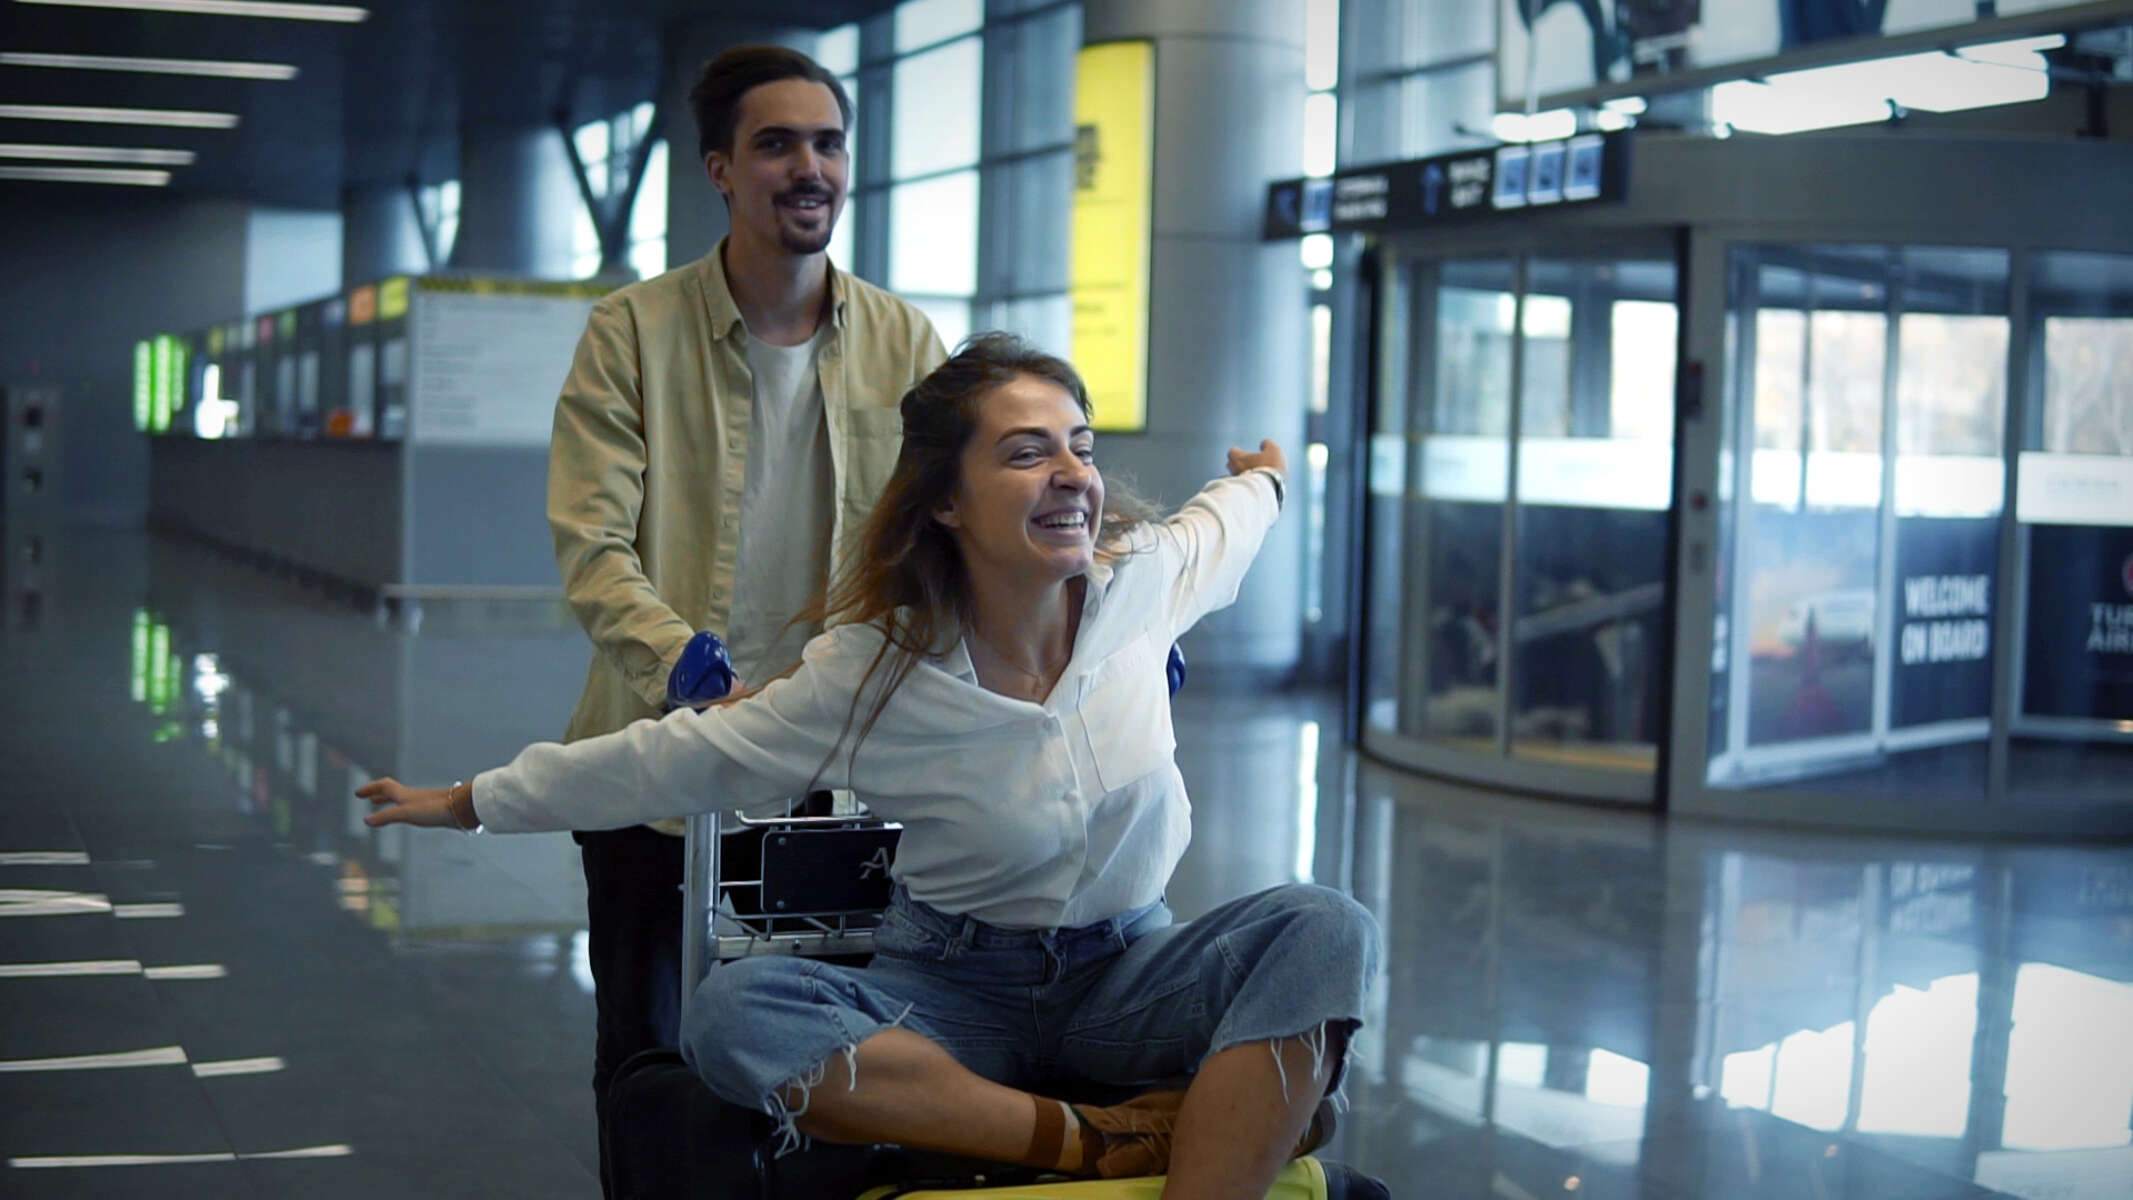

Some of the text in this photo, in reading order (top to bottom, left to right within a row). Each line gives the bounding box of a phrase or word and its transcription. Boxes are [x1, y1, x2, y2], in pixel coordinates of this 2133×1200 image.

[1904, 575, 1987, 617] WELCOME
[1901, 619, 1987, 665] ON BOARD
